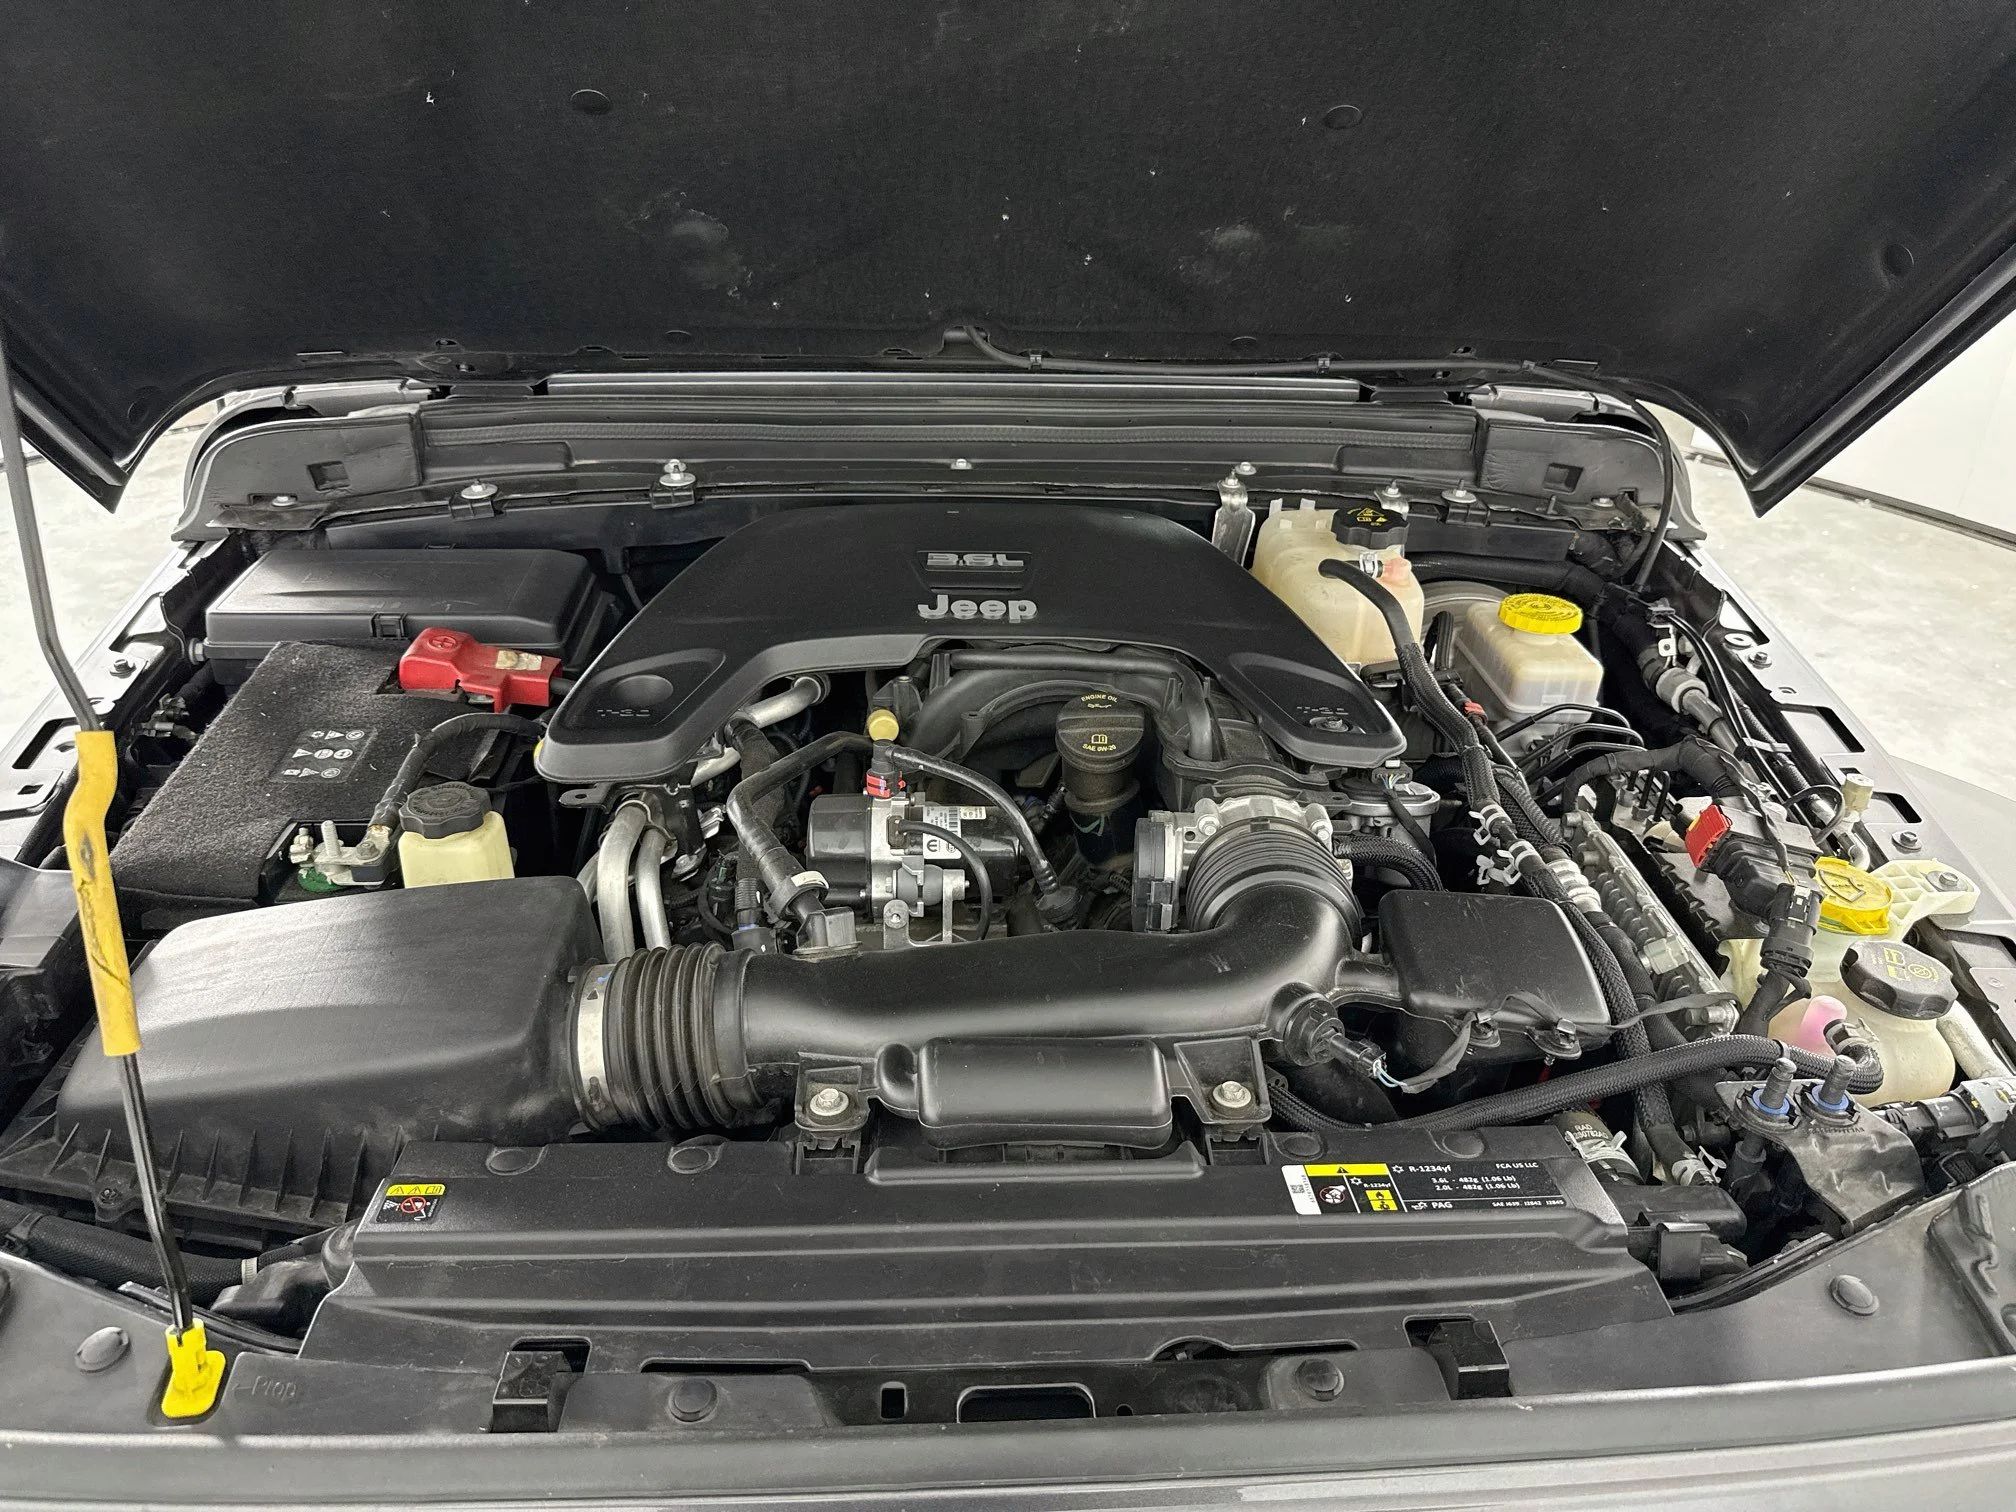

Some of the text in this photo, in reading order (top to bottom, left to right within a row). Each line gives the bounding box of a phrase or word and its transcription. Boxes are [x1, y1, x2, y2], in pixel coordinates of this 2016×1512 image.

[917, 594, 1037, 624] Jeep
[1081, 694, 1118, 703] ENGINE OIL
[1082, 743, 1117, 752] SAE 0W-20
[1408, 1164, 1452, 1173] R-1234yf
[1431, 1201, 1453, 1209] PAG
[252, 1375, 297, 1402] Prop
